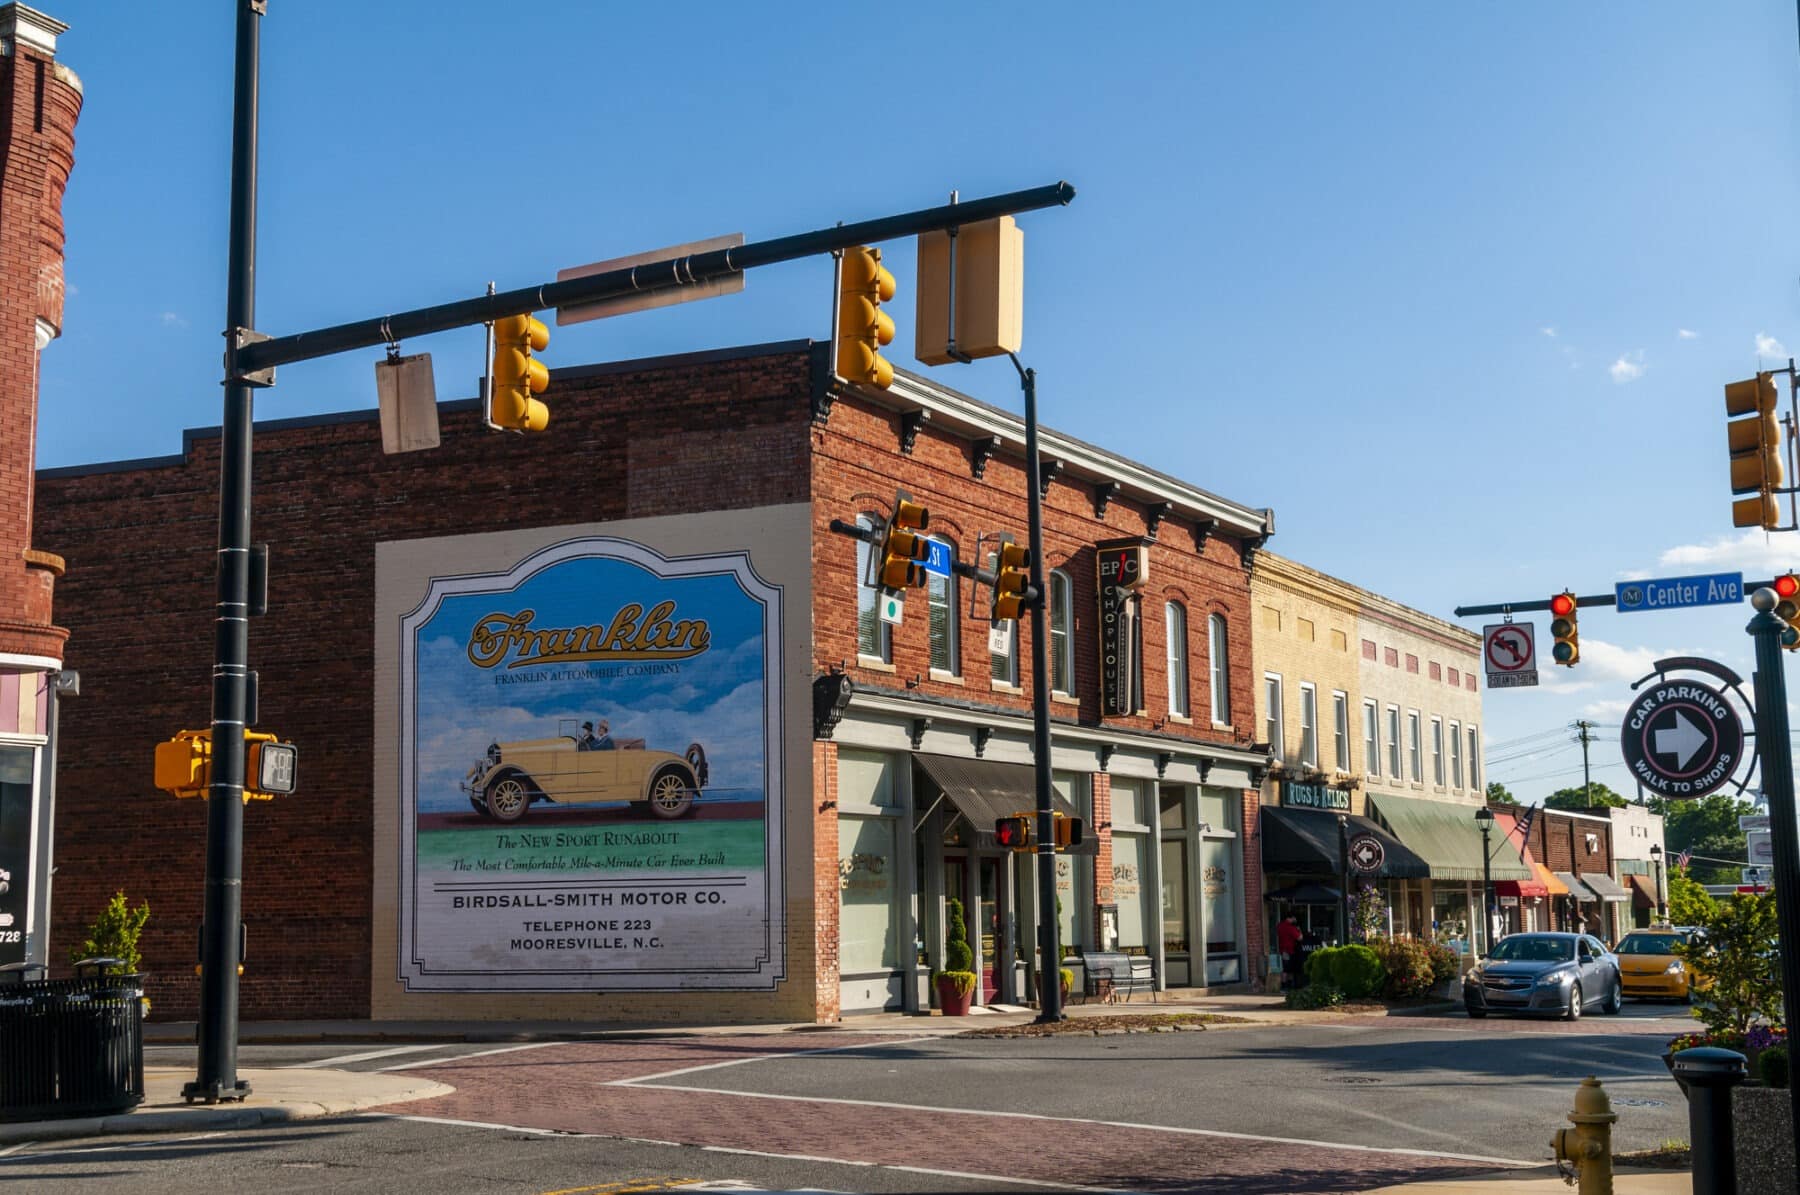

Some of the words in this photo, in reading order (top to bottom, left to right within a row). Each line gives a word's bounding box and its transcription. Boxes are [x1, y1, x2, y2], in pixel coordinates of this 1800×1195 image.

[1647, 583, 1699, 606] Center
[1707, 579, 1738, 601] Ave
[467, 600, 711, 669] Franklin
[495, 671, 548, 685] FRANKLIN
[550, 668, 624, 681] AUTOMOBILE
[626, 664, 681, 677] COMPANY
[1630, 698, 1656, 729] CAR
[1656, 686, 1727, 720] PARKING
[1635, 759, 1669, 790] WALK
[1672, 782, 1690, 792] TO
[1695, 753, 1731, 790] SHOPS
[1289, 782, 1312, 805] RUGS
[1313, 785, 1319, 807] &
[1321, 786, 1349, 809] RELICS
[497, 835, 517, 849] The
[556, 833, 601, 847] SPORT
[604, 832, 680, 846] RUNABOUT
[453, 859, 472, 872] The
[476, 859, 501, 871] Most
[505, 858, 567, 872] Comfortable
[570, 857, 643, 869] Mile-a-Minute
[646, 856, 667, 868] Car
[671, 855, 695, 867] Ever
[699, 851, 726, 866] Built
[453, 893, 614, 909] BIRDSALL-SMITH
[621, 892, 687, 905] MOTOR
[694, 891, 727, 905] CO.
[523, 920, 619, 932] TELEPHONE
[623, 919, 652, 931] 223
[633, 937, 665, 949] N.C.
